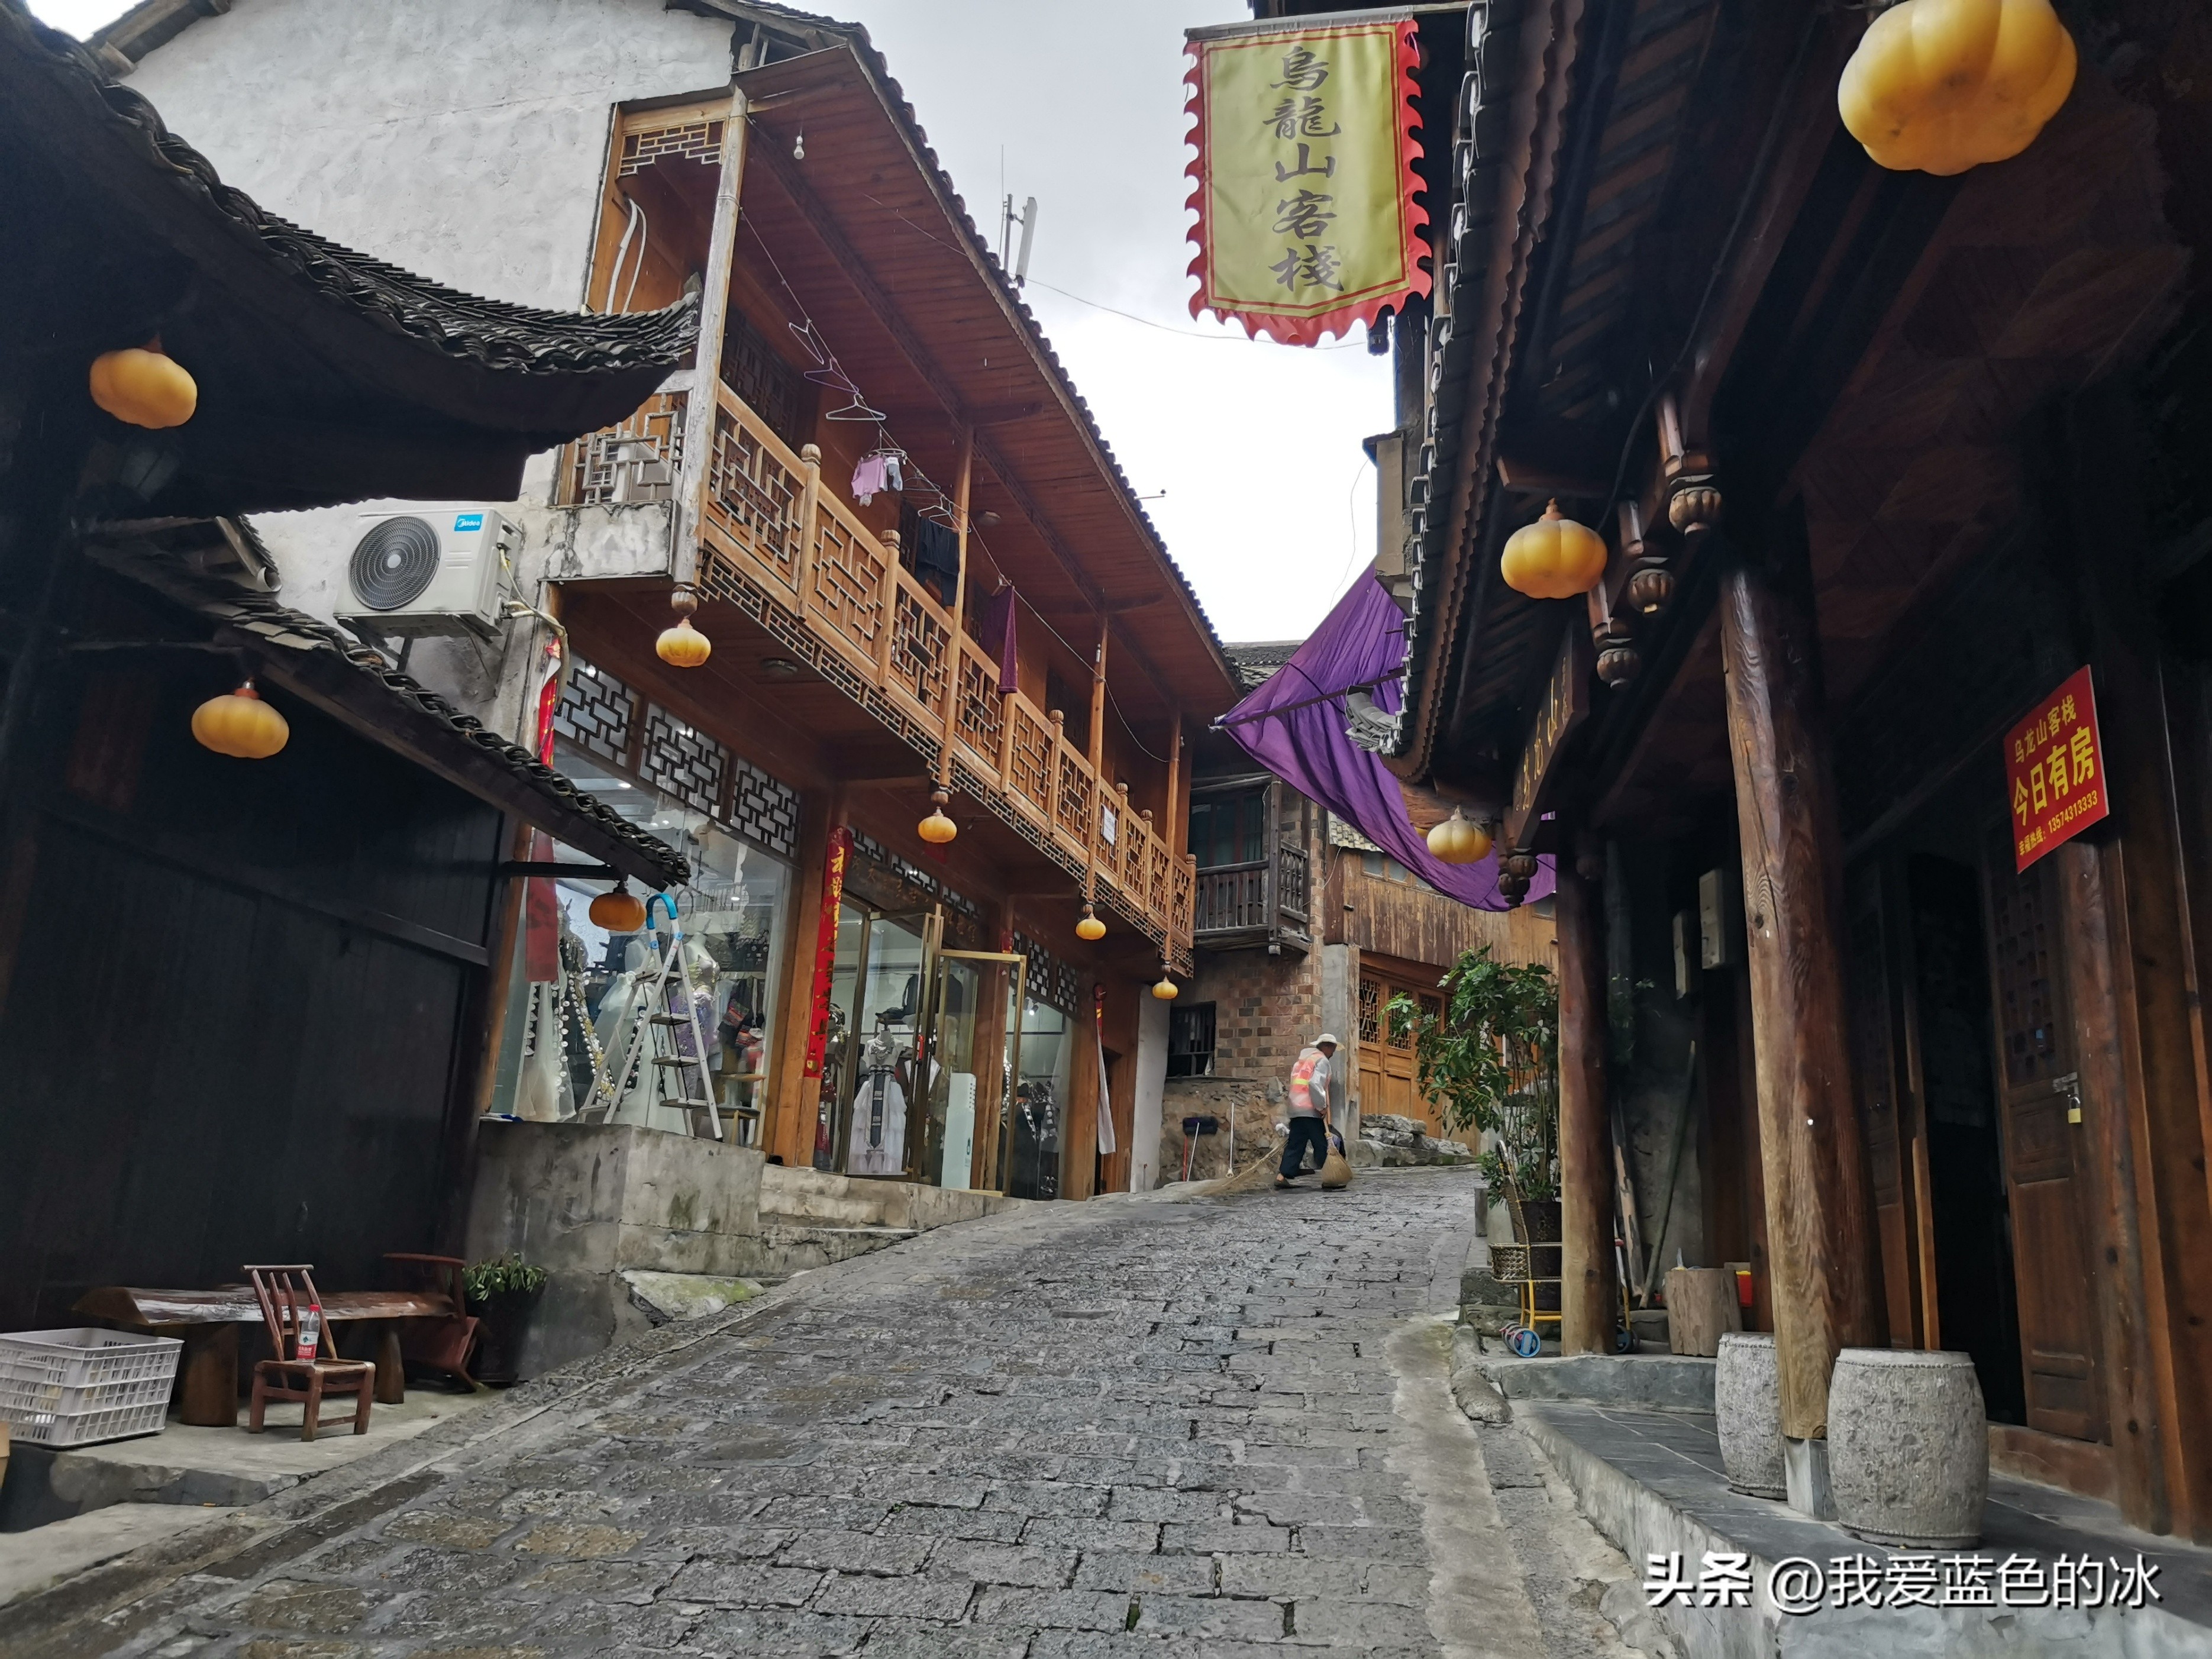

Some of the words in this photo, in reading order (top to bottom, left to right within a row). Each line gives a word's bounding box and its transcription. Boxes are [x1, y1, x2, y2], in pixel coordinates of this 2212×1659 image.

[2014, 694, 2077, 764] 乌龙山客栈
[2013, 725, 2095, 827] 今日有房
